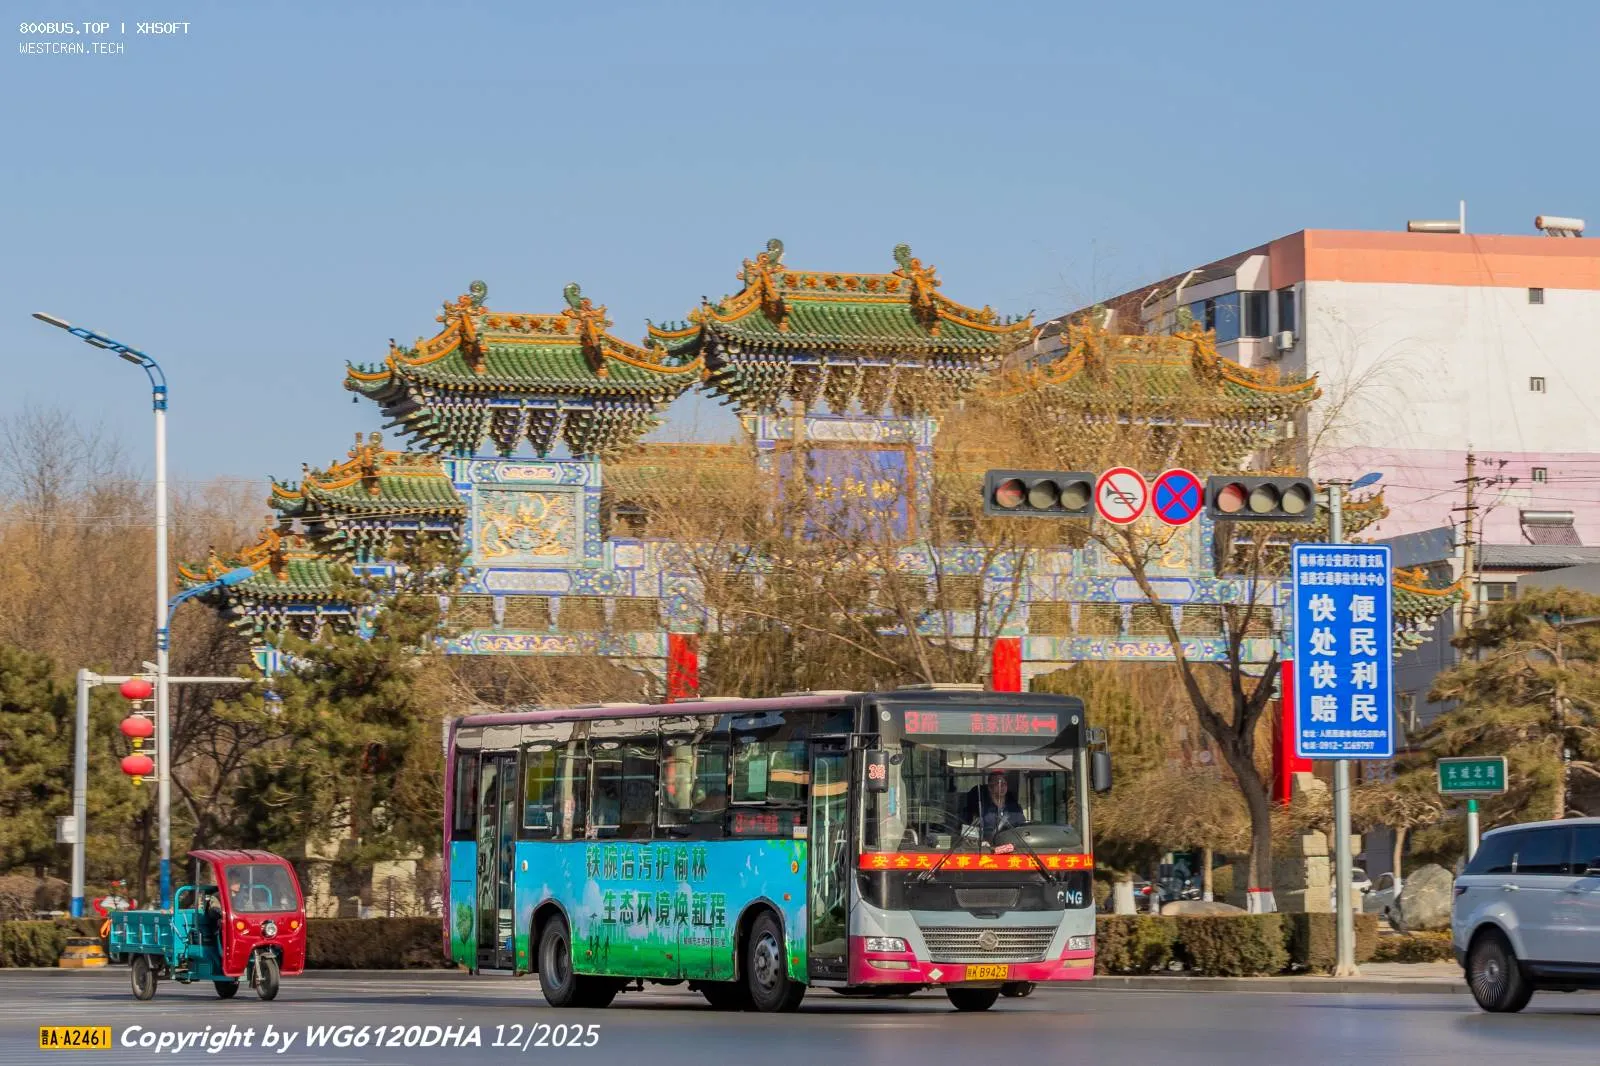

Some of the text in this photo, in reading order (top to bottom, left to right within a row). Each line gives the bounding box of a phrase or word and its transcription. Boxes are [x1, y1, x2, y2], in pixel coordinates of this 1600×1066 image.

[1308, 593, 1338, 723] 快处快赔
[1348, 594, 1379, 723] 便民利民
[586, 844, 708, 882] 铁腕治污护榆林
[602, 889, 727, 928] 生态环境焕新程
[1057, 891, 1083, 904] CNG
